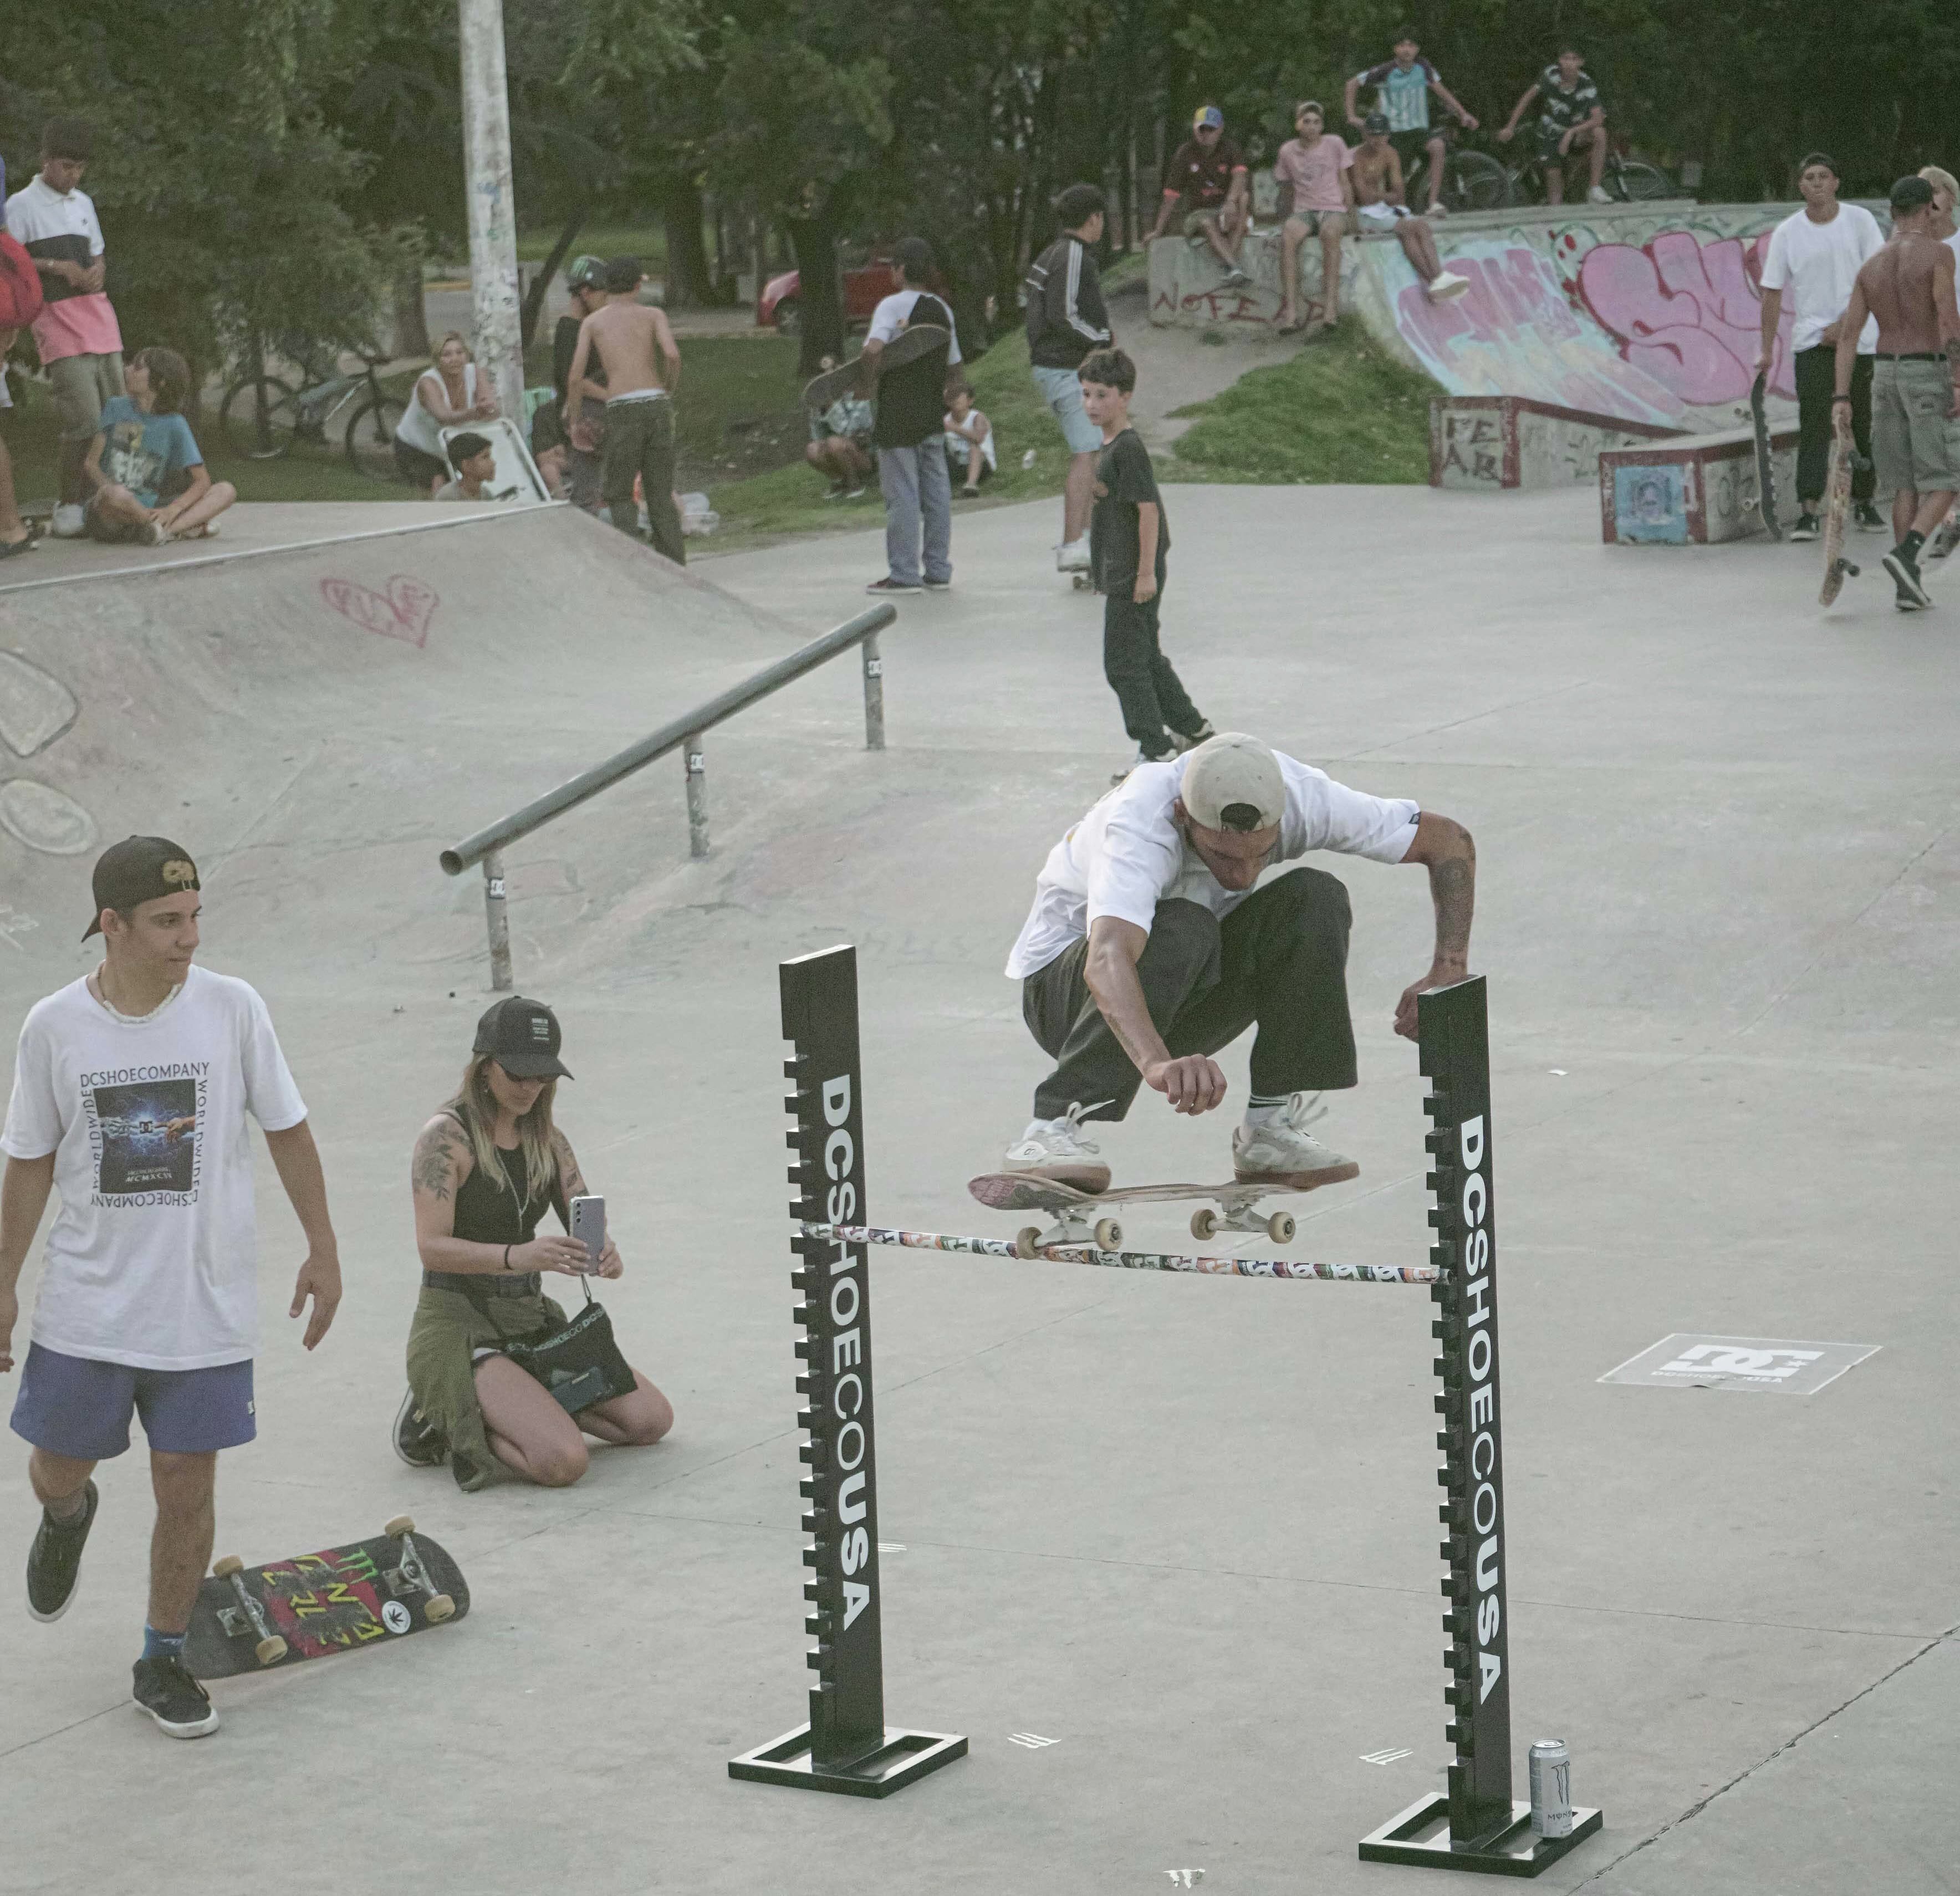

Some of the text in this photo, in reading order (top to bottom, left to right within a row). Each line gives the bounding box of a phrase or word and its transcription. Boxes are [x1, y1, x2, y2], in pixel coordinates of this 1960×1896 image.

[81, 1062, 210, 1087] DCSHOECOMPANY
[90, 1189, 198, 1207] DSHOECOMPANY
[823, 1074, 870, 1632] DCSHOECOUSA
[1461, 1115, 1500, 1705] DCSHOECOUSA
